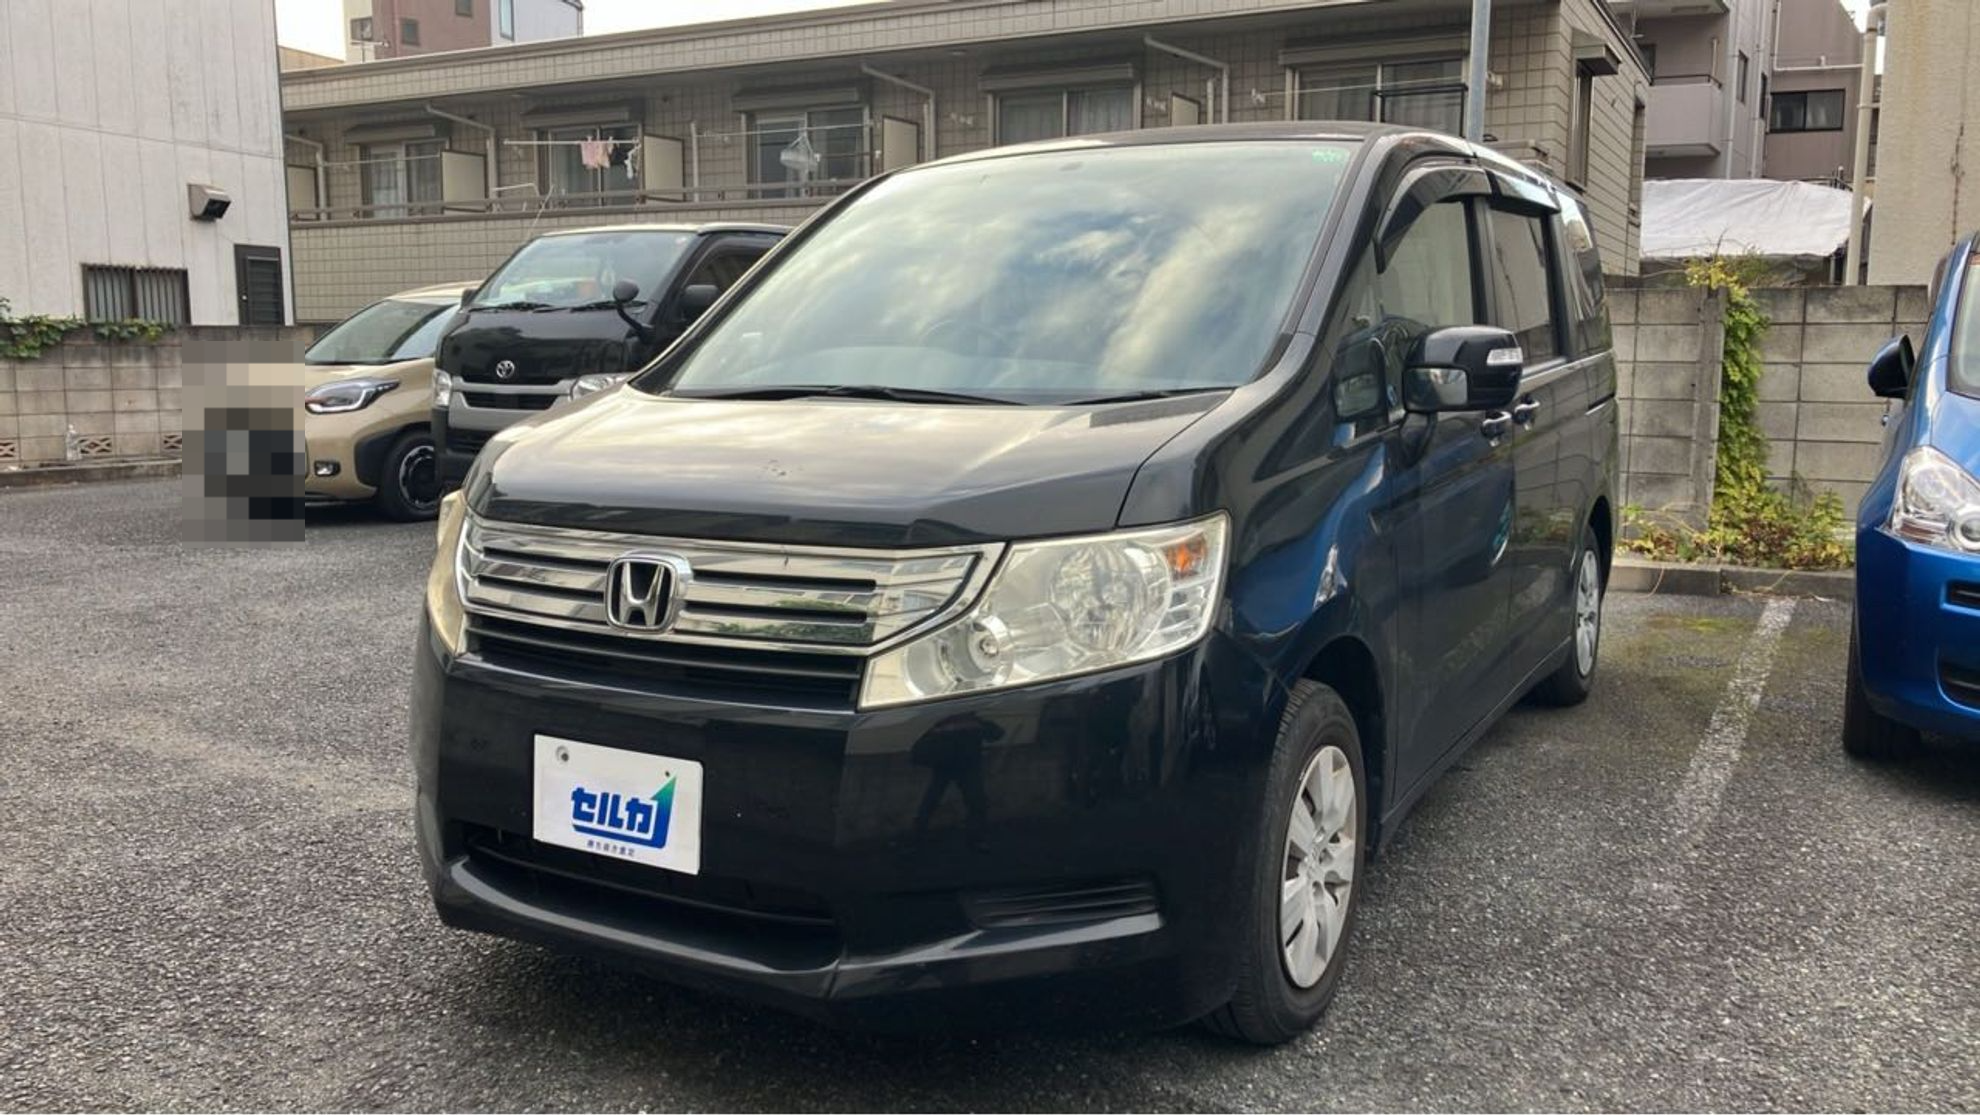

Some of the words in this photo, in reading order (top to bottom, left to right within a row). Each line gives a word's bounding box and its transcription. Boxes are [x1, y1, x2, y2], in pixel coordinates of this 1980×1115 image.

[619, 561, 665, 627] H
[571, 787, 654, 835] セルカ
